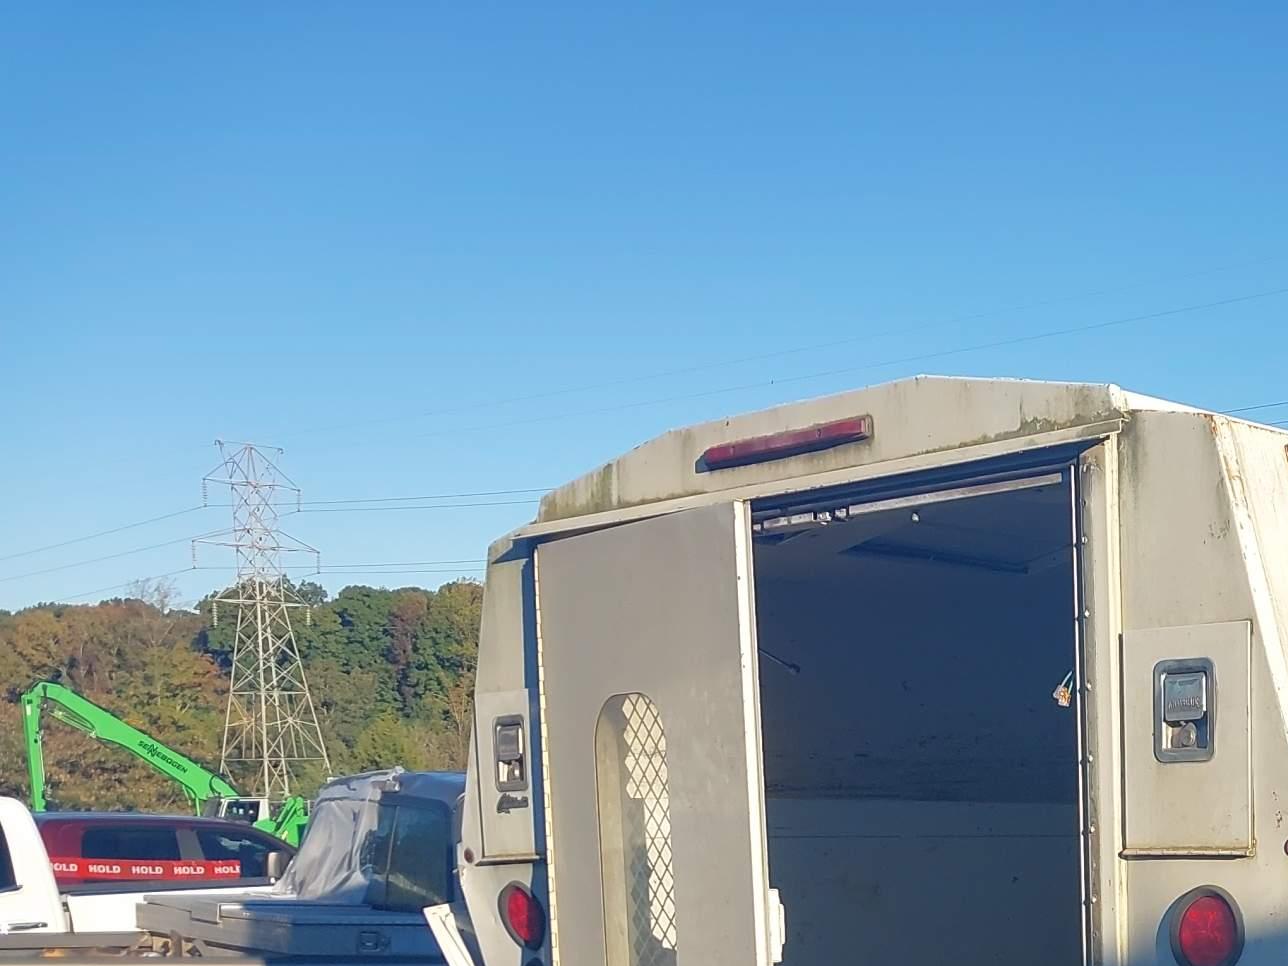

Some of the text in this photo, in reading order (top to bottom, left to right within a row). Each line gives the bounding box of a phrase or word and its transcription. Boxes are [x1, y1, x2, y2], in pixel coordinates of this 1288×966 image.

[137, 740, 188, 773] SENNEBOGEN
[52, 862, 78, 872] OLD
[89, 864, 121, 873] HOLD
[132, 865, 163, 874] HOLD
[174, 865, 205, 874] HOLD
